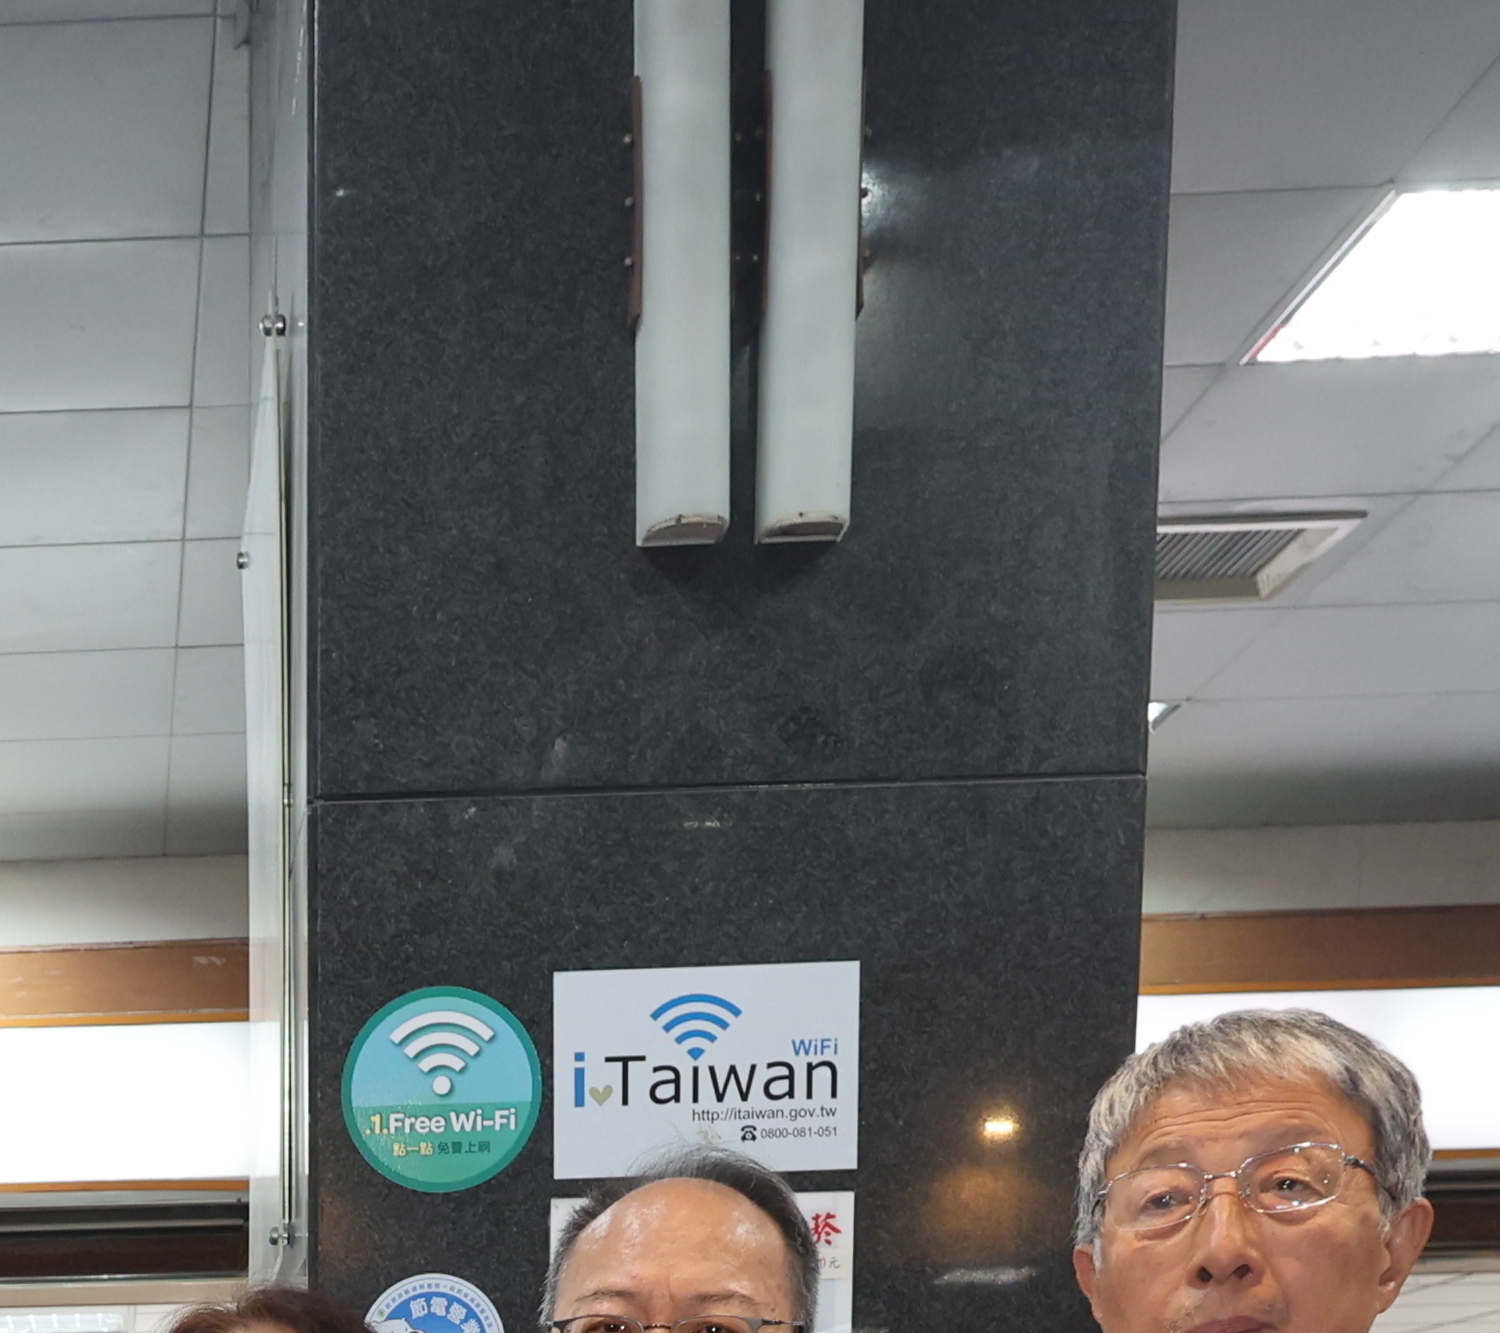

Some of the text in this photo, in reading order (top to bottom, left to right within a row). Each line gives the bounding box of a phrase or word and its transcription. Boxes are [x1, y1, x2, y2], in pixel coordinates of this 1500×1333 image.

[790, 1037, 840, 1057] WiFi
[451, 1108, 517, 1133] Wi-Fi
[691, 1104, 838, 1124] http://itaiwan.gov.tw
[759, 1124, 839, 1141] 0800-081-051
[391, 1141, 491, 1158] 點一點 免費上網
